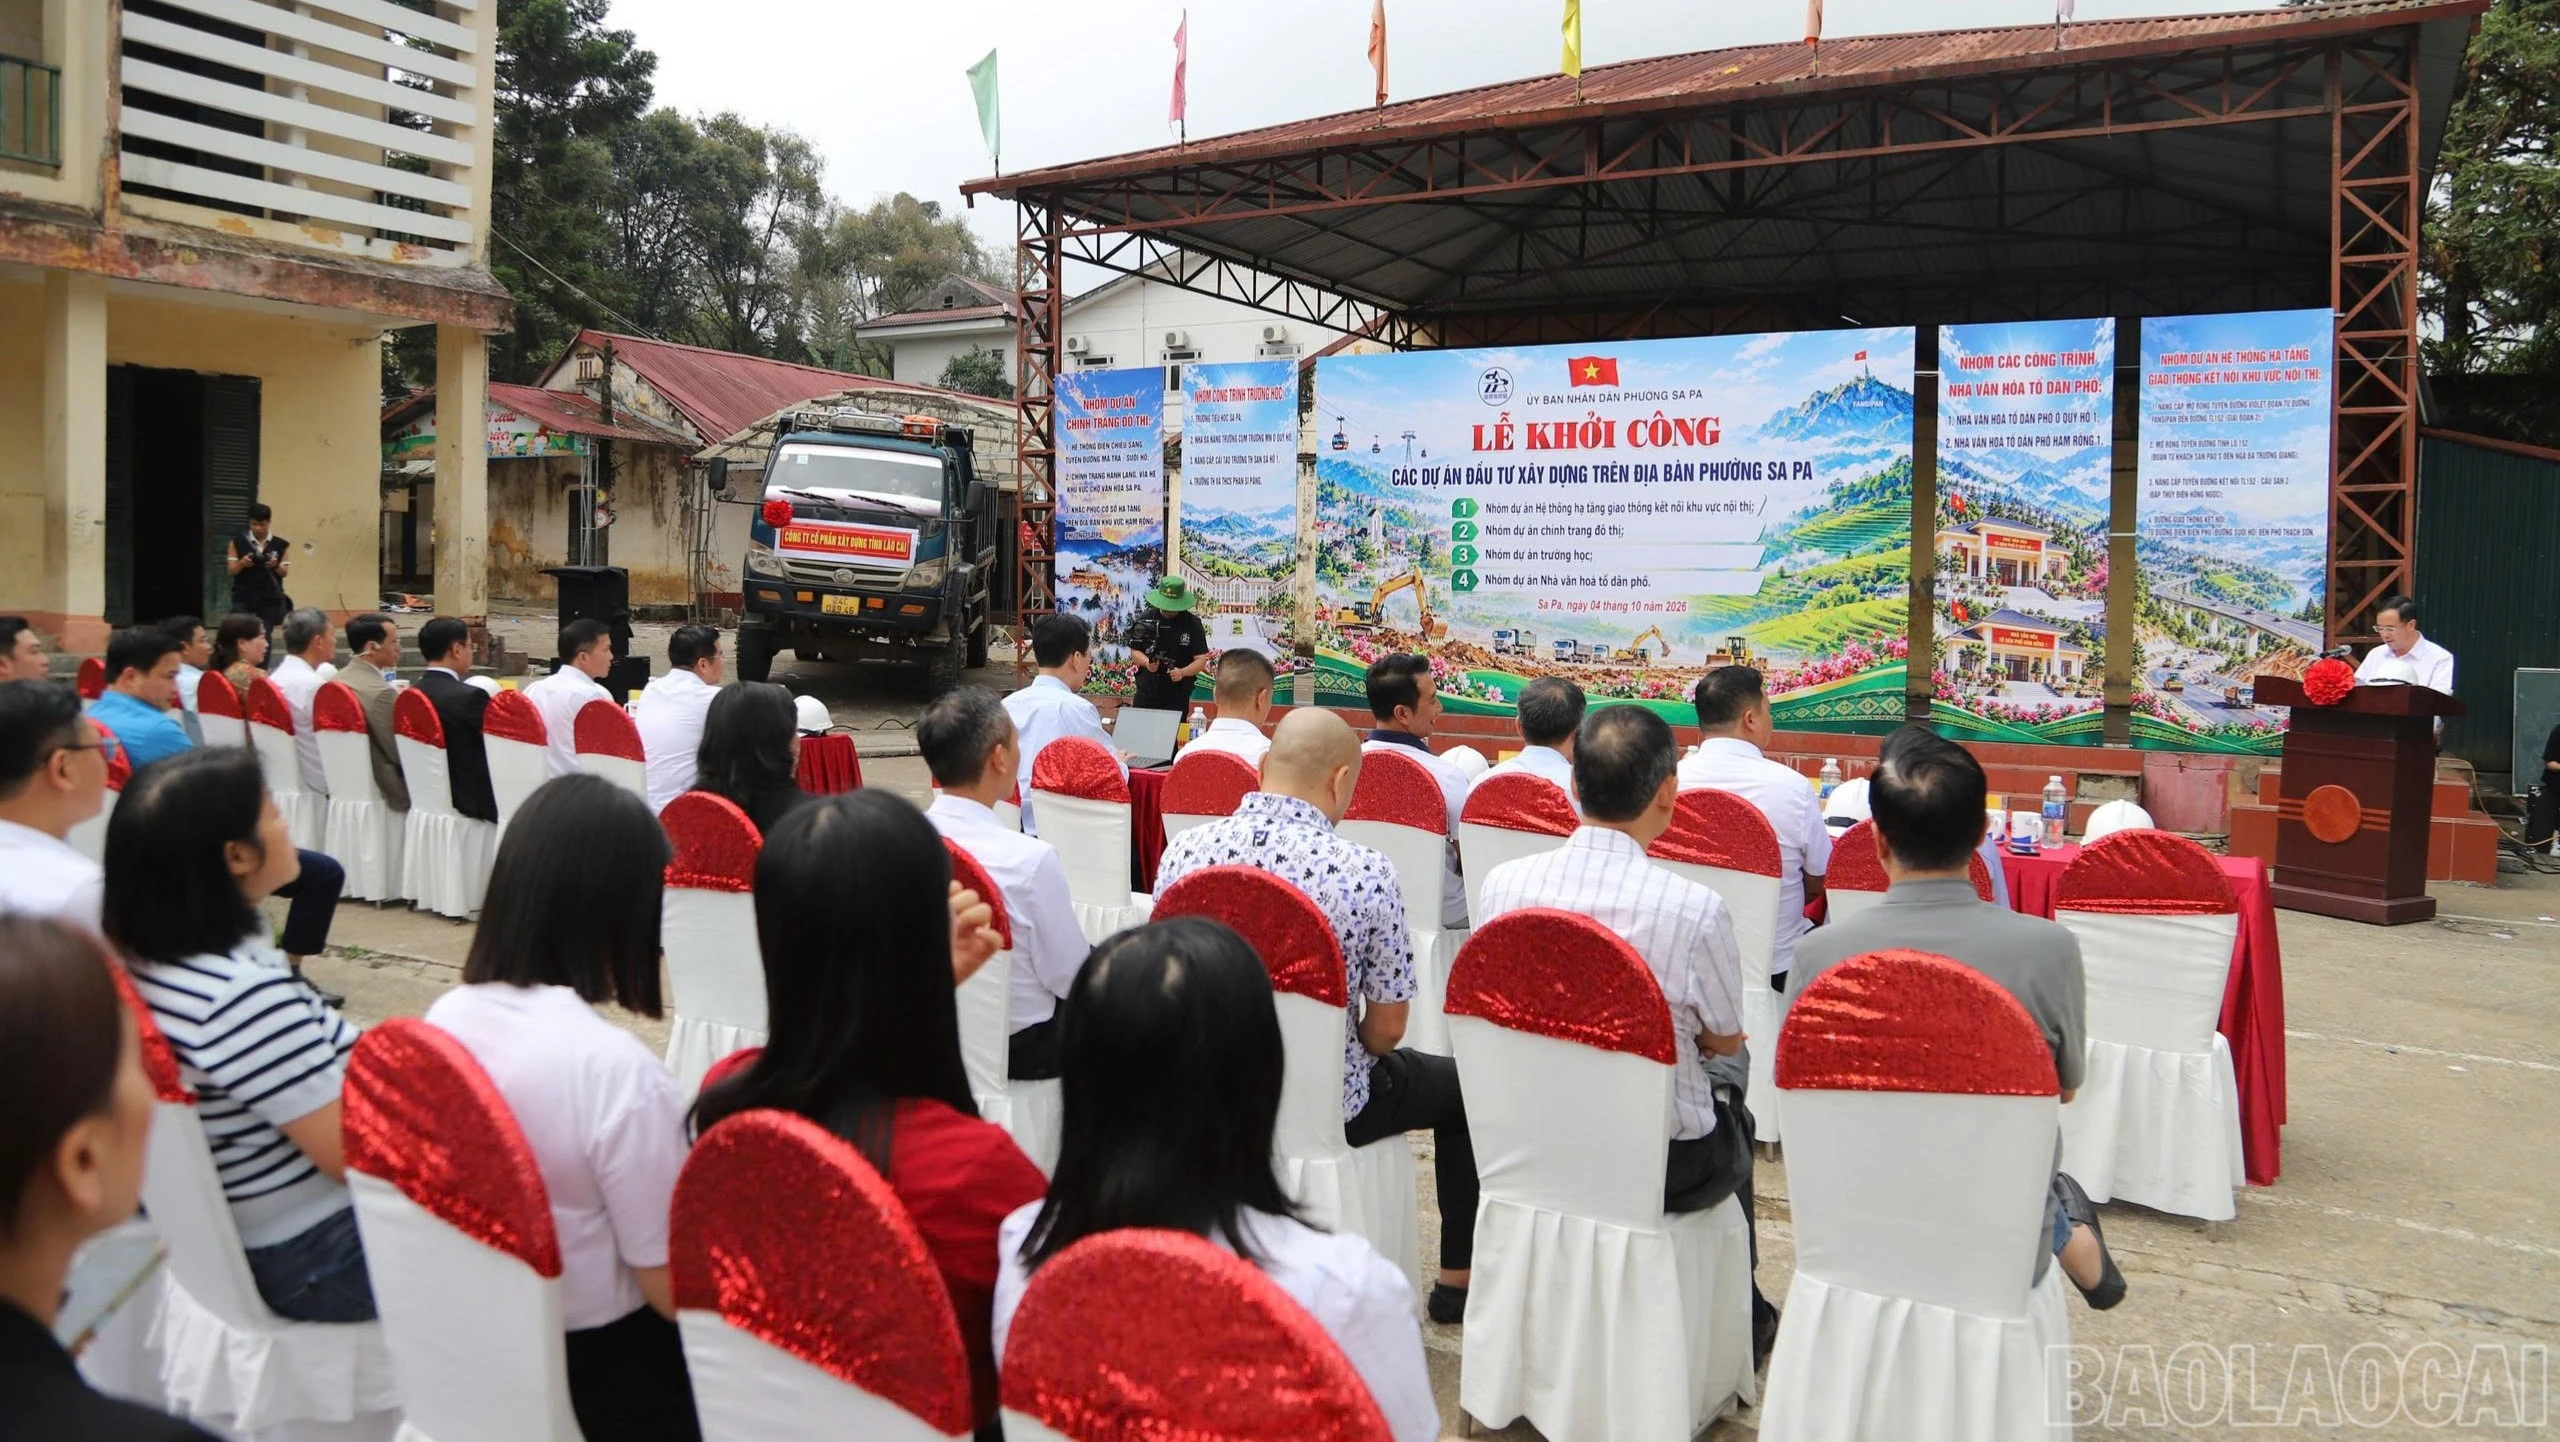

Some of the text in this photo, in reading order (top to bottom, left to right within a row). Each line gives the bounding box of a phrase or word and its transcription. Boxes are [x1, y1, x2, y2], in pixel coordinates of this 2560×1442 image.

[1960, 350, 2095, 369] NHÓM CÁC CÔNG TRÌNH
[2161, 347, 2308, 367] NHÓM DỰ ÁN HỆ THỐNG HẠ TẦNG
[2149, 369, 2321, 385] GIAO THÔNG KẾT NỐI KHU VỰC NỘI THỊ:
[1949, 376, 2101, 397] NHÀ VĂN HÓA TỔ DÂN PHỐ:
[1527, 390, 1702, 405] ỦY BAN NHÂN DÂN PHƯỜNG SA PA
[1472, 410, 1721, 451] LỄ KHỞI CÔNG
[1392, 458, 1812, 489] CÁC DỰ ÁN ĐẦU TƯ XÂY DỰNG TRÊN ĐỊA BÀN PHƯỜNG SA PA
[1460, 500, 1754, 516] 1 Nhóm dự án Hệ thống hạ tầng giao thông kết nối khu vực nội thị;
[1459, 524, 1624, 538] 2 Nhóm dự án chỉnh trang đô thị;
[1459, 548, 1592, 563] 3 Nhóm dự án trường học;
[1459, 573, 1650, 589] 4 Nhóm dự án Nhà văn hoá tổ dân phố.
[1538, 599, 1686, 613] Sa Pa, ngày 04 tháng 10 năm 2026
